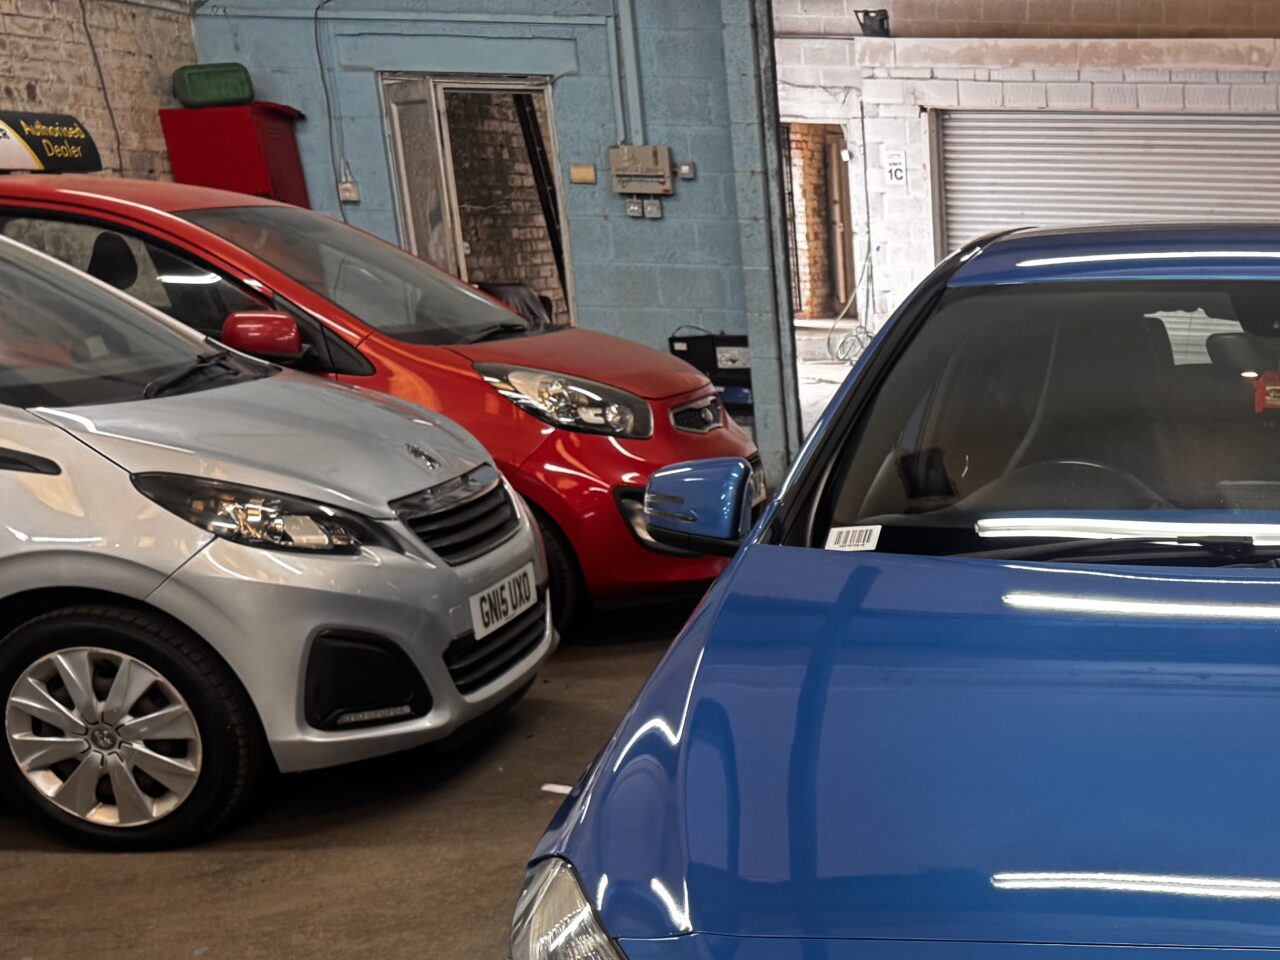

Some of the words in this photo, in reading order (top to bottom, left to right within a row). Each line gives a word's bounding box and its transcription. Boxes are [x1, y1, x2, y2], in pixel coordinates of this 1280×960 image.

[20, 120, 86, 139] Authorised
[41, 139, 82, 157] Dealer
[888, 168, 904, 180] 1C
[480, 585, 509, 628] GN15
